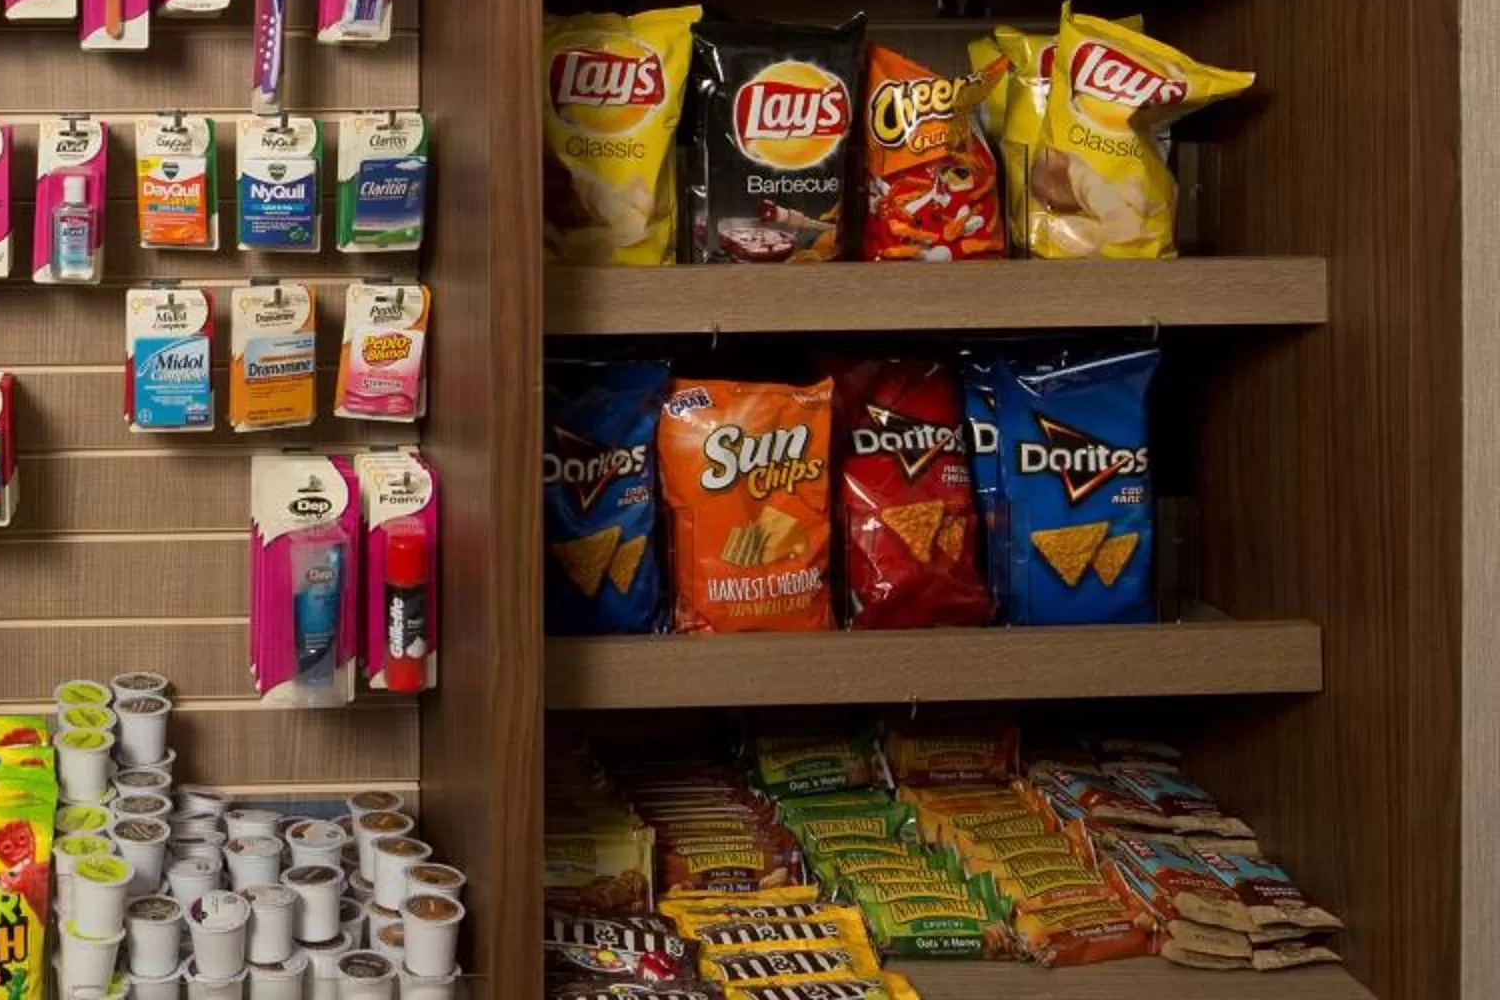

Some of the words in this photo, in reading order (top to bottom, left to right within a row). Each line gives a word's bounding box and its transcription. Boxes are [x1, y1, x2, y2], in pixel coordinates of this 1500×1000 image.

[558, 52, 659, 105] Lay's
[745, 85, 844, 140] Lay's
[564, 135, 646, 159] Classic
[1067, 124, 1145, 159] Classic
[143, 183, 201, 200] DayQuil
[250, 184, 306, 202] NyQuil
[359, 180, 408, 197] Claritin
[747, 175, 840, 194] Barbecue
[155, 311, 188, 323] Midol
[153, 353, 204, 372] Midol
[365, 347, 411, 362] Bismol
[248, 359, 314, 377] Dramamine
[700, 424, 809, 490] Sun
[1020, 442, 1149, 475] Doritos
[749, 458, 824, 499] Chips
[296, 498, 330, 516] Dep
[378, 494, 427, 506] Foamy
[308, 568, 334, 580] Dep
[707, 576, 765, 601] HARVEST
[766, 566, 823, 598] CHEDDAR
[389, 596, 405, 659] Gillette
[915, 936, 939, 951] Oats
[951, 936, 982, 951] Honey
